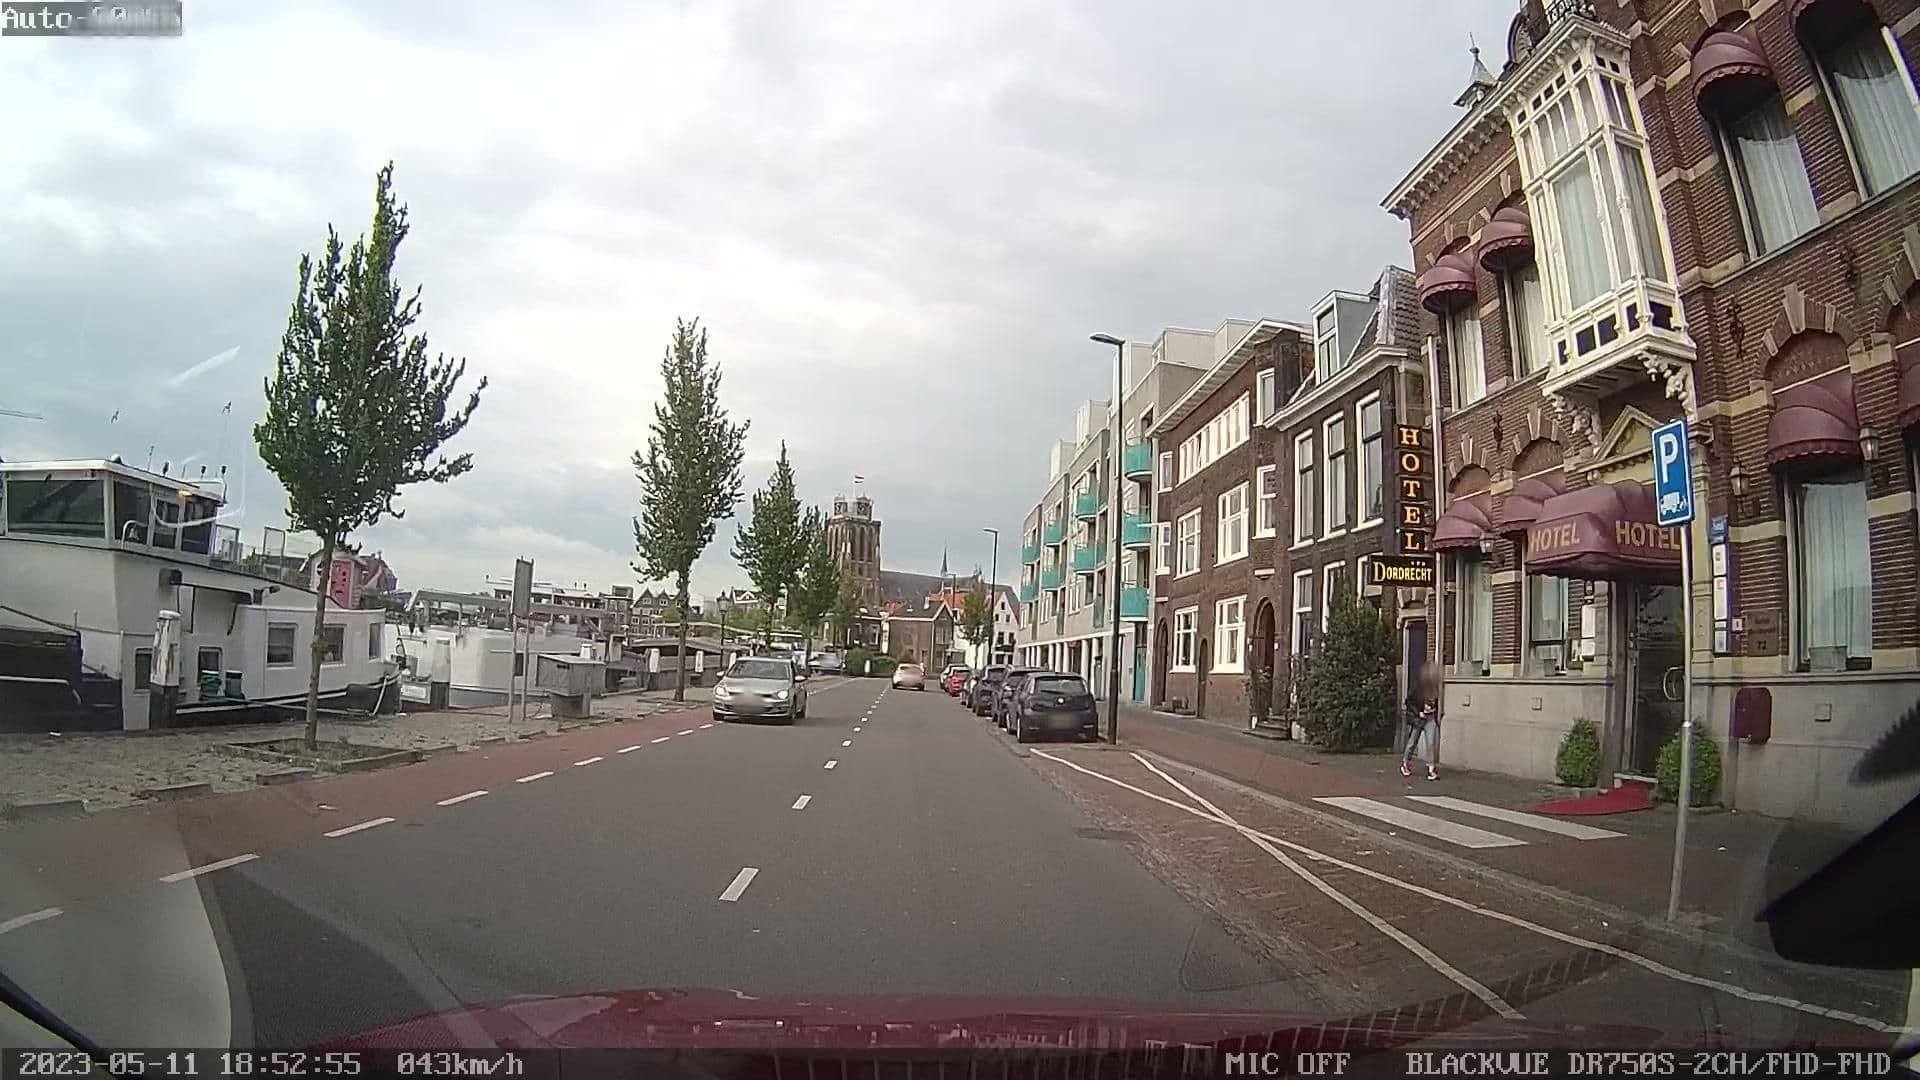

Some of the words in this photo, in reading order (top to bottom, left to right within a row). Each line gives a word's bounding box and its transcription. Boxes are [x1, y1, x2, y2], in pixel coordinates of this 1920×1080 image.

[1659, 432, 1679, 484] P
[1399, 427, 1421, 550] HOTEL
[1529, 521, 1581, 553] HOTEL
[1615, 519, 1682, 551] HOTEL
[1372, 561, 1433, 582] DORDRECHT
